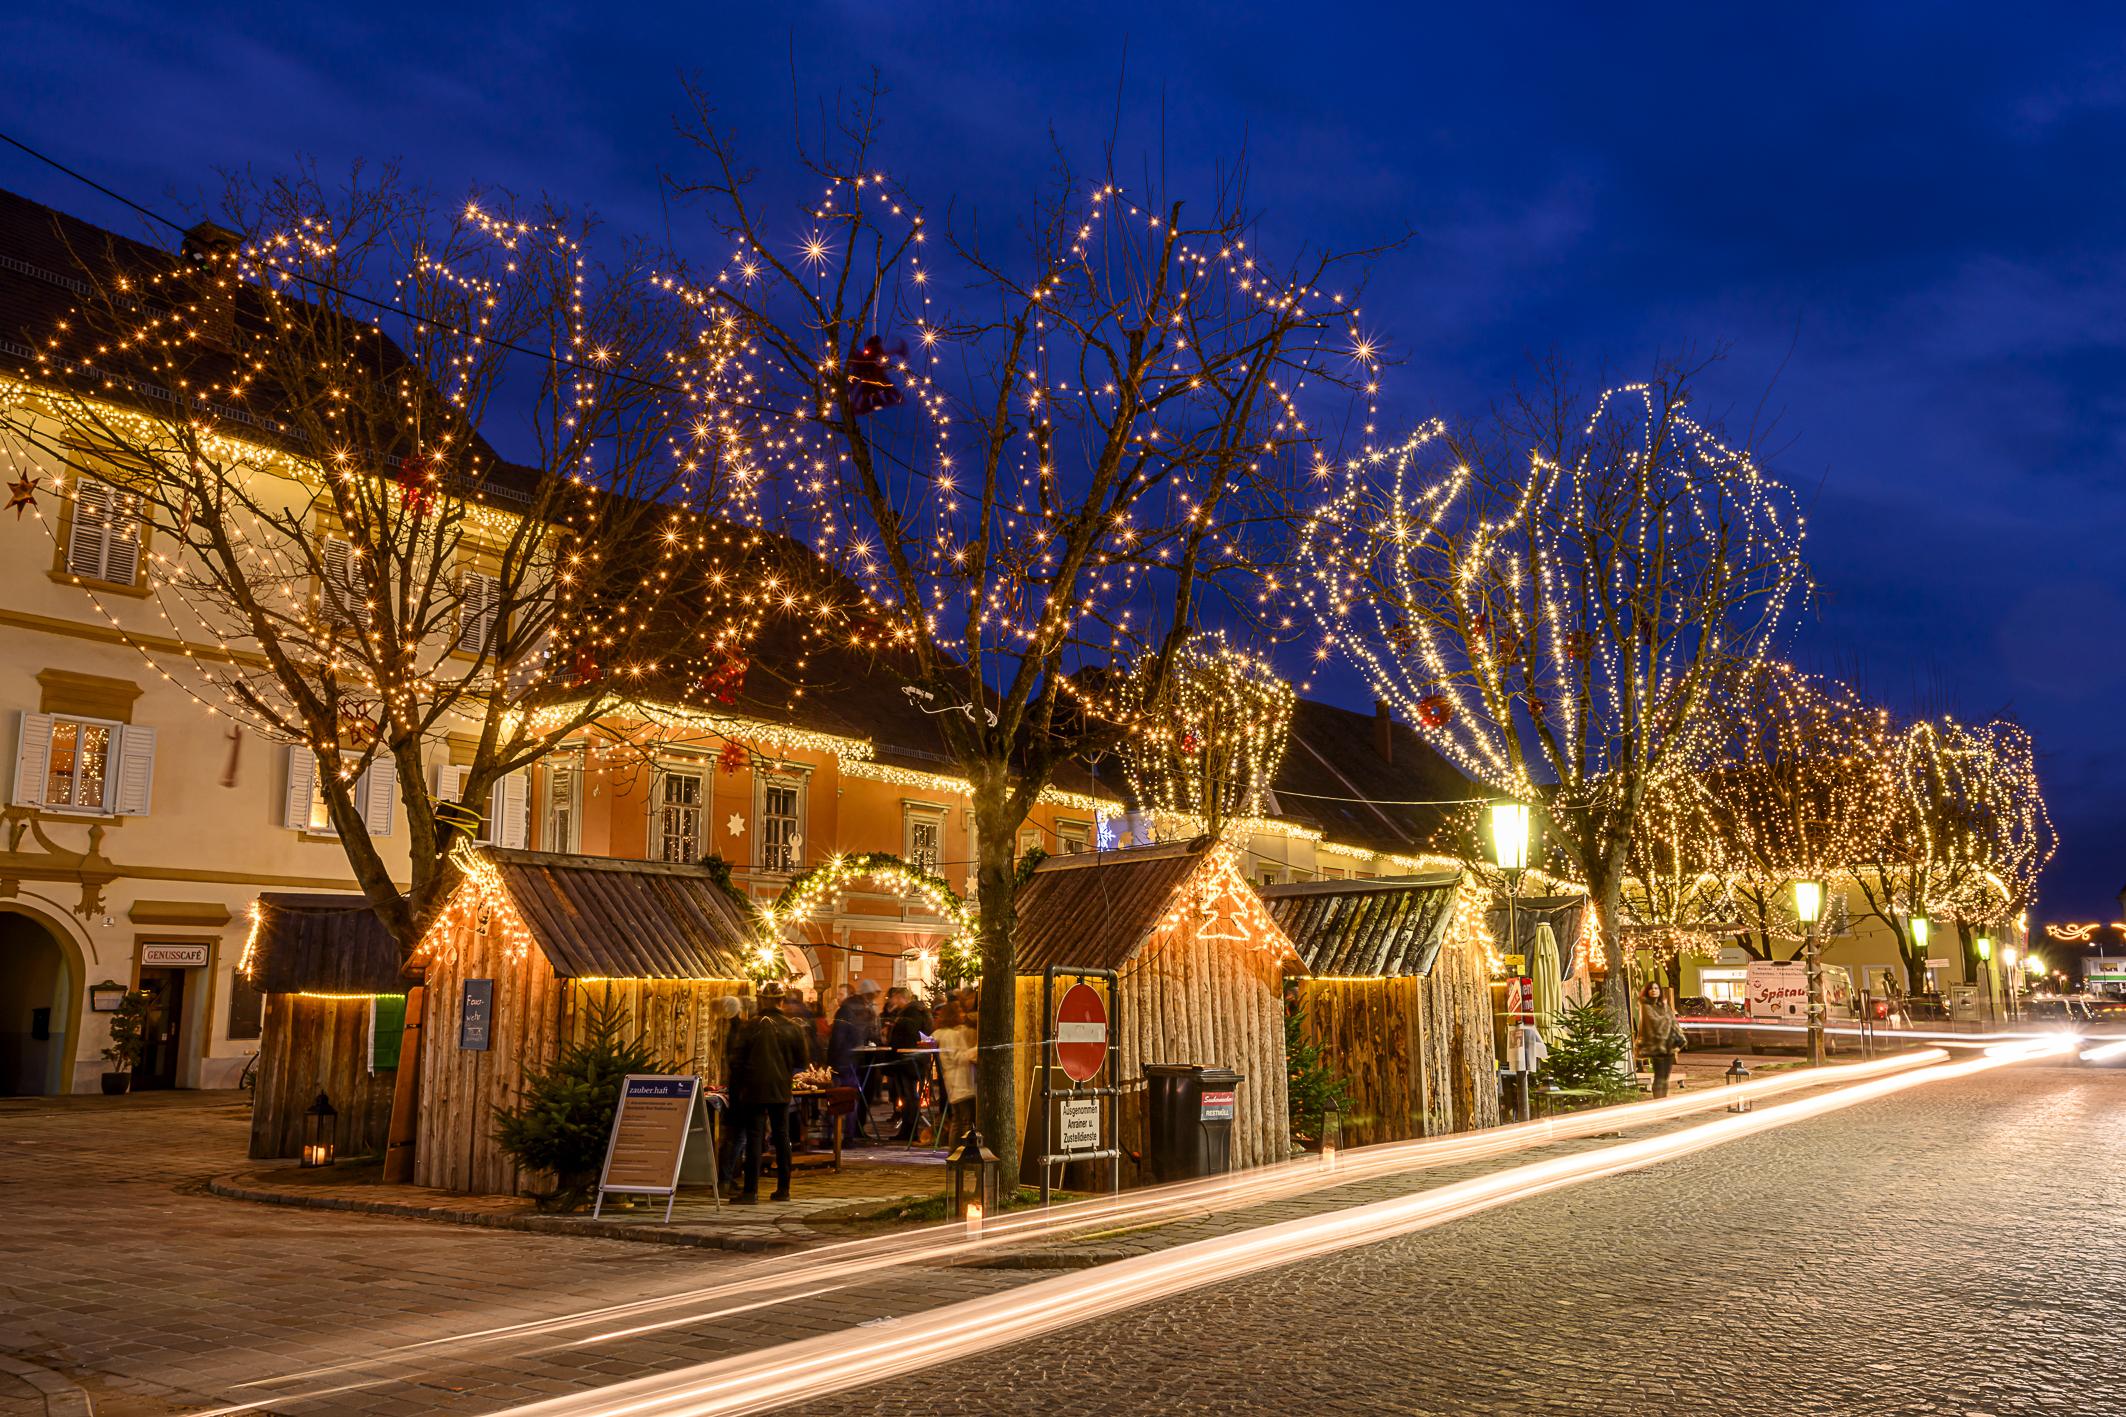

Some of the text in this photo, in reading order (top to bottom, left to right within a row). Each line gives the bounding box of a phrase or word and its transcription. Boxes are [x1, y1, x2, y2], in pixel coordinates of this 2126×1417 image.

[147, 949, 202, 960] GENUSSCAFÉ
[1754, 987, 1807, 1004] Spätau
[1063, 1106, 1098, 1117] Ausgenommen
[1205, 1108, 1230, 1117] RESTMÜLL
[1067, 1119, 1087, 1129] Anrainer
[1063, 1131, 1097, 1143] Zustelldienste
